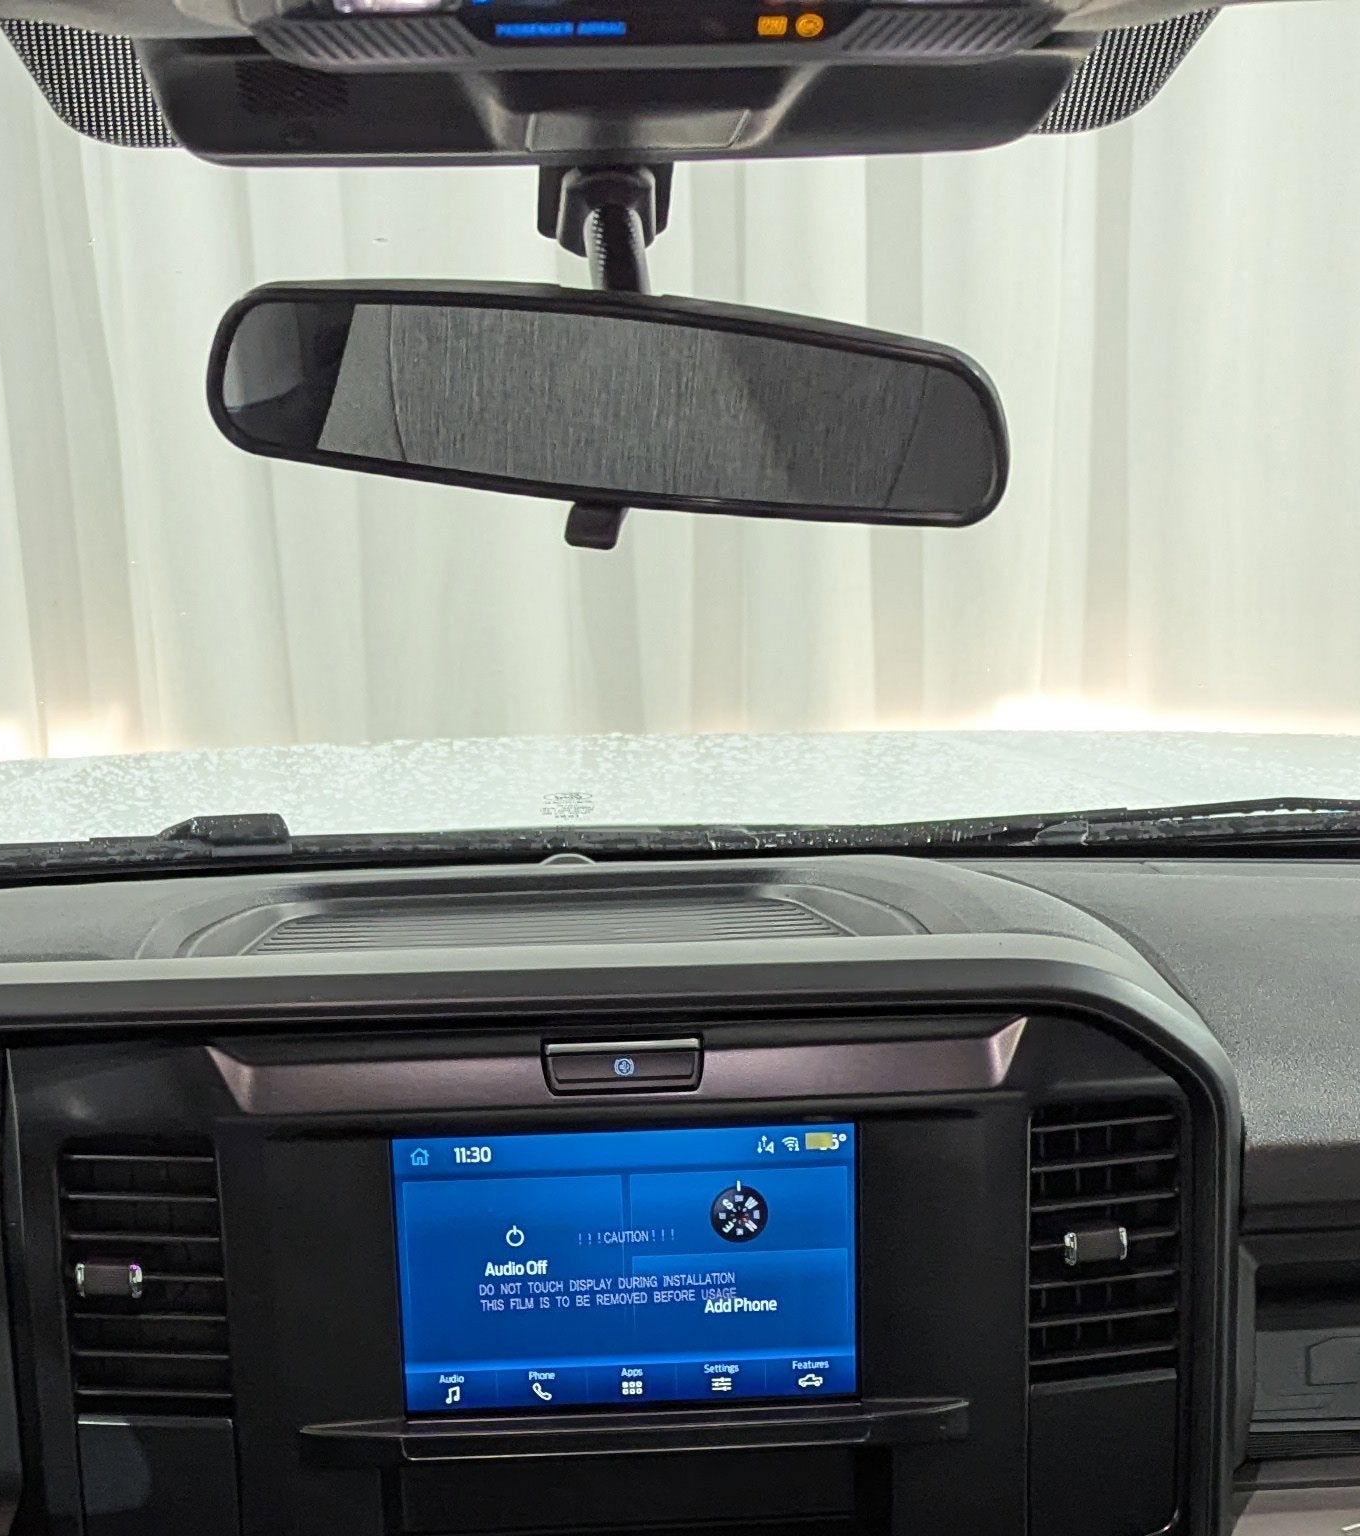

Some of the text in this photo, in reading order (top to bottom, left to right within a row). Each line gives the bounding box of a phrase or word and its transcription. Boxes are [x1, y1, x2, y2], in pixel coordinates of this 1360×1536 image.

[453, 1146, 492, 1164] 11:30
[484, 1259, 549, 1277] Audio Off
[479, 1272, 736, 1297] DO NOT TOUCH DISPLAY DURING INSTALLATION
[480, 1286, 737, 1312] THIS FILM IS TO BE REMOVED BEFORE USAGE
[704, 1297, 778, 1314] Add Phone
[703, 1362, 740, 1376] Settings
[791, 1358, 830, 1371] Features
[439, 1374, 465, 1385] Audio
[528, 1370, 556, 1382] Phone
[621, 1367, 644, 1379] Apps
